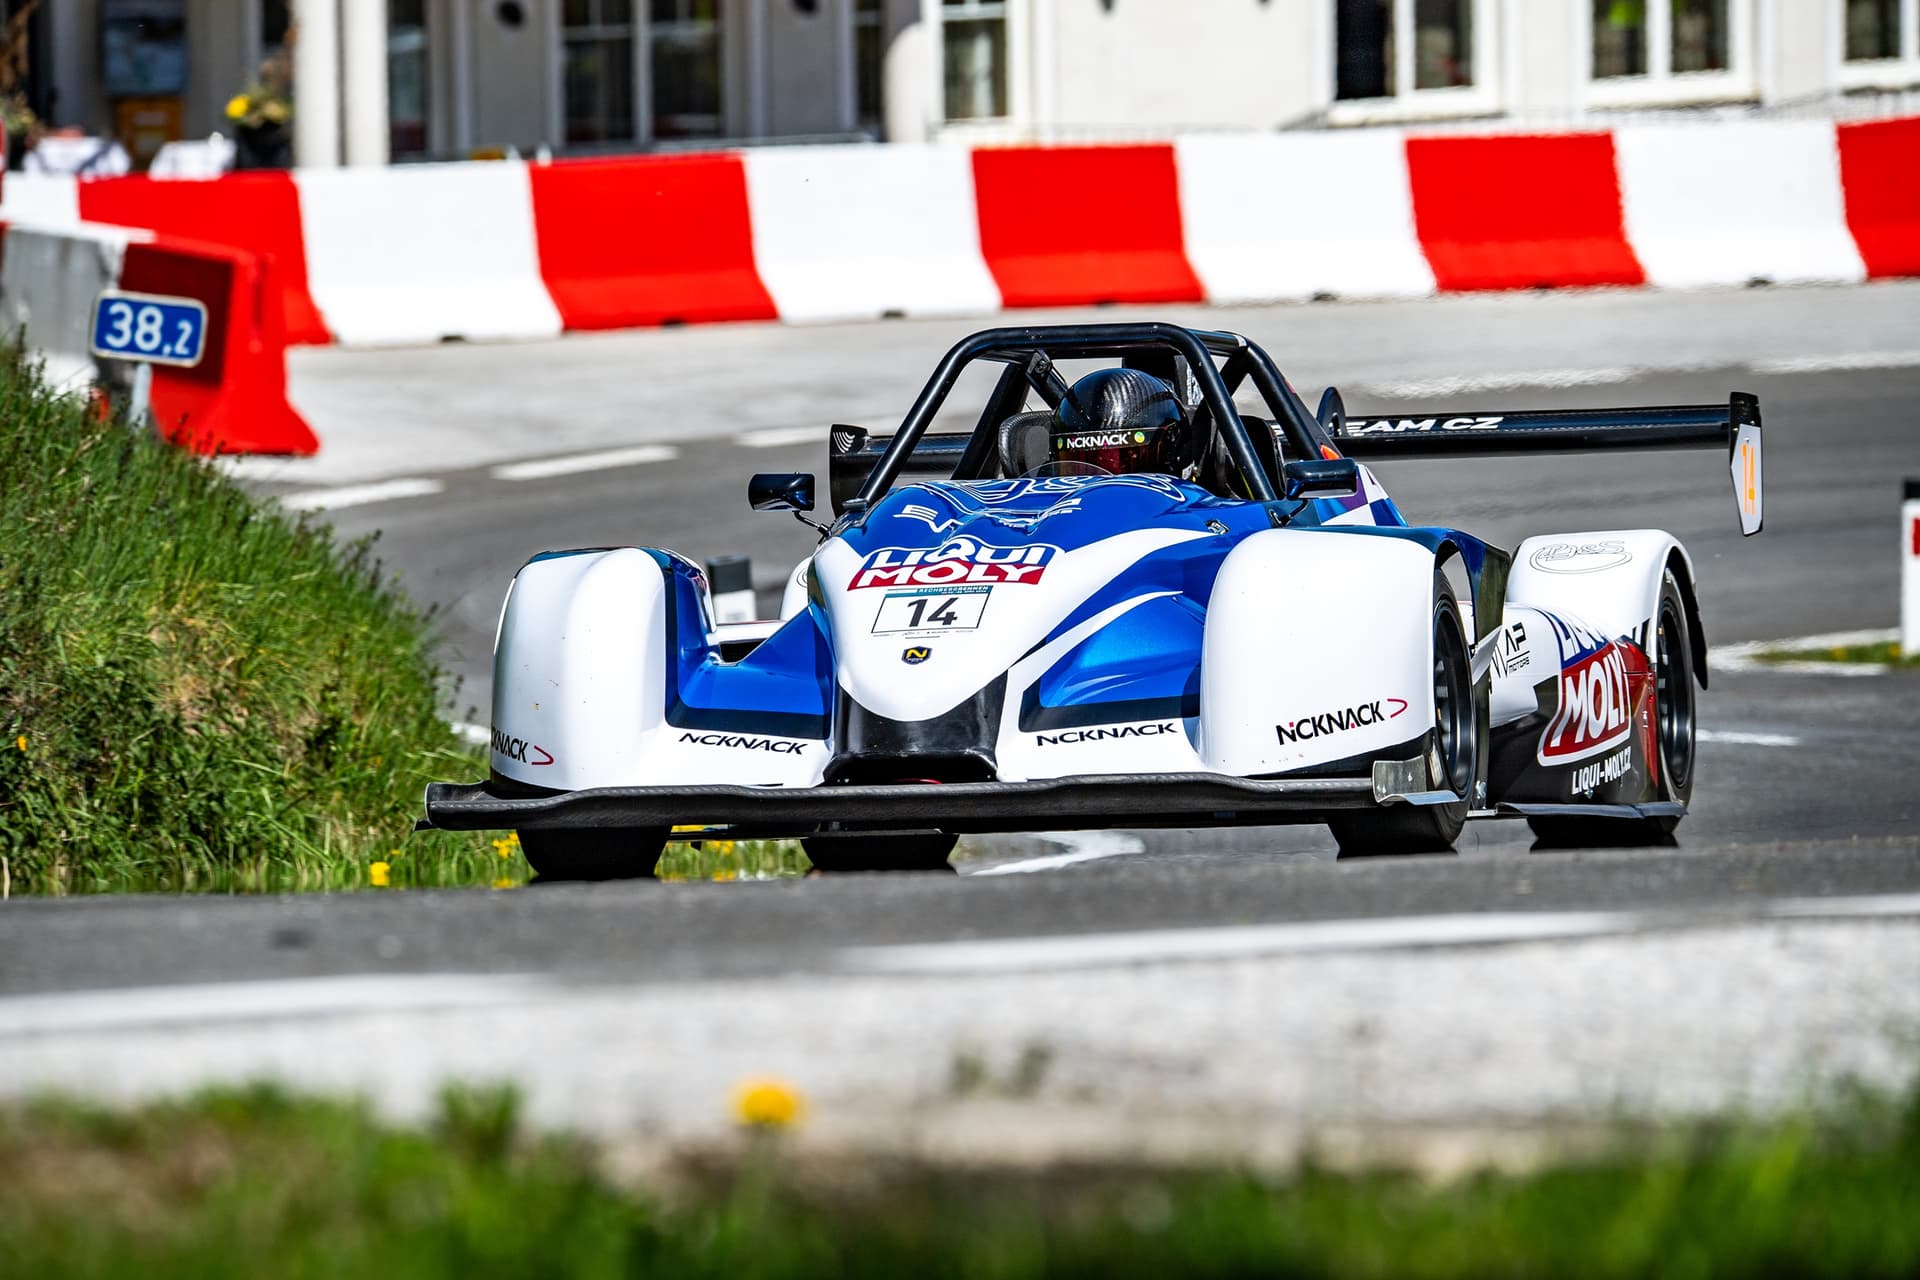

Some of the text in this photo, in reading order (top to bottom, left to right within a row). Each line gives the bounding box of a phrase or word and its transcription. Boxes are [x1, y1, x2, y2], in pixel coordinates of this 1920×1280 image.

[1441, 416, 1504, 431] CZ
[1740, 443, 1756, 516] 14
[870, 537, 1047, 569] LIQUI
[855, 559, 1045, 588] MOLY
[907, 597, 959, 628] 14
[1550, 648, 1626, 748] MOLY
